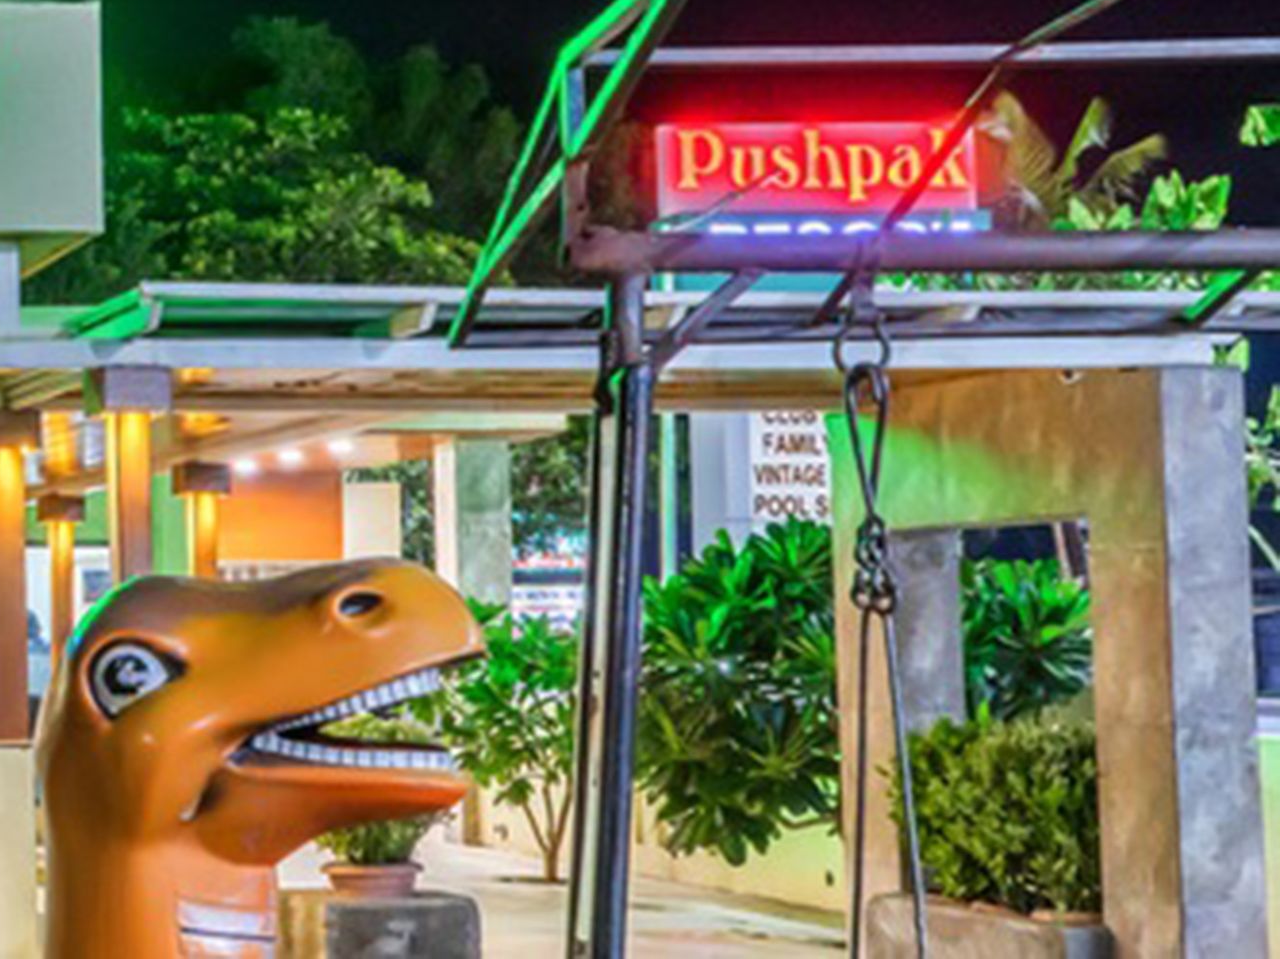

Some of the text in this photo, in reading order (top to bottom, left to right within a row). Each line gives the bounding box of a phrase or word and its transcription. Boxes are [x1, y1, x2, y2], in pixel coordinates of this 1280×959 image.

[675, 128, 971, 202] Pushpak
[753, 464, 826, 487] VINTAGE
[754, 493, 809, 517] POOL
